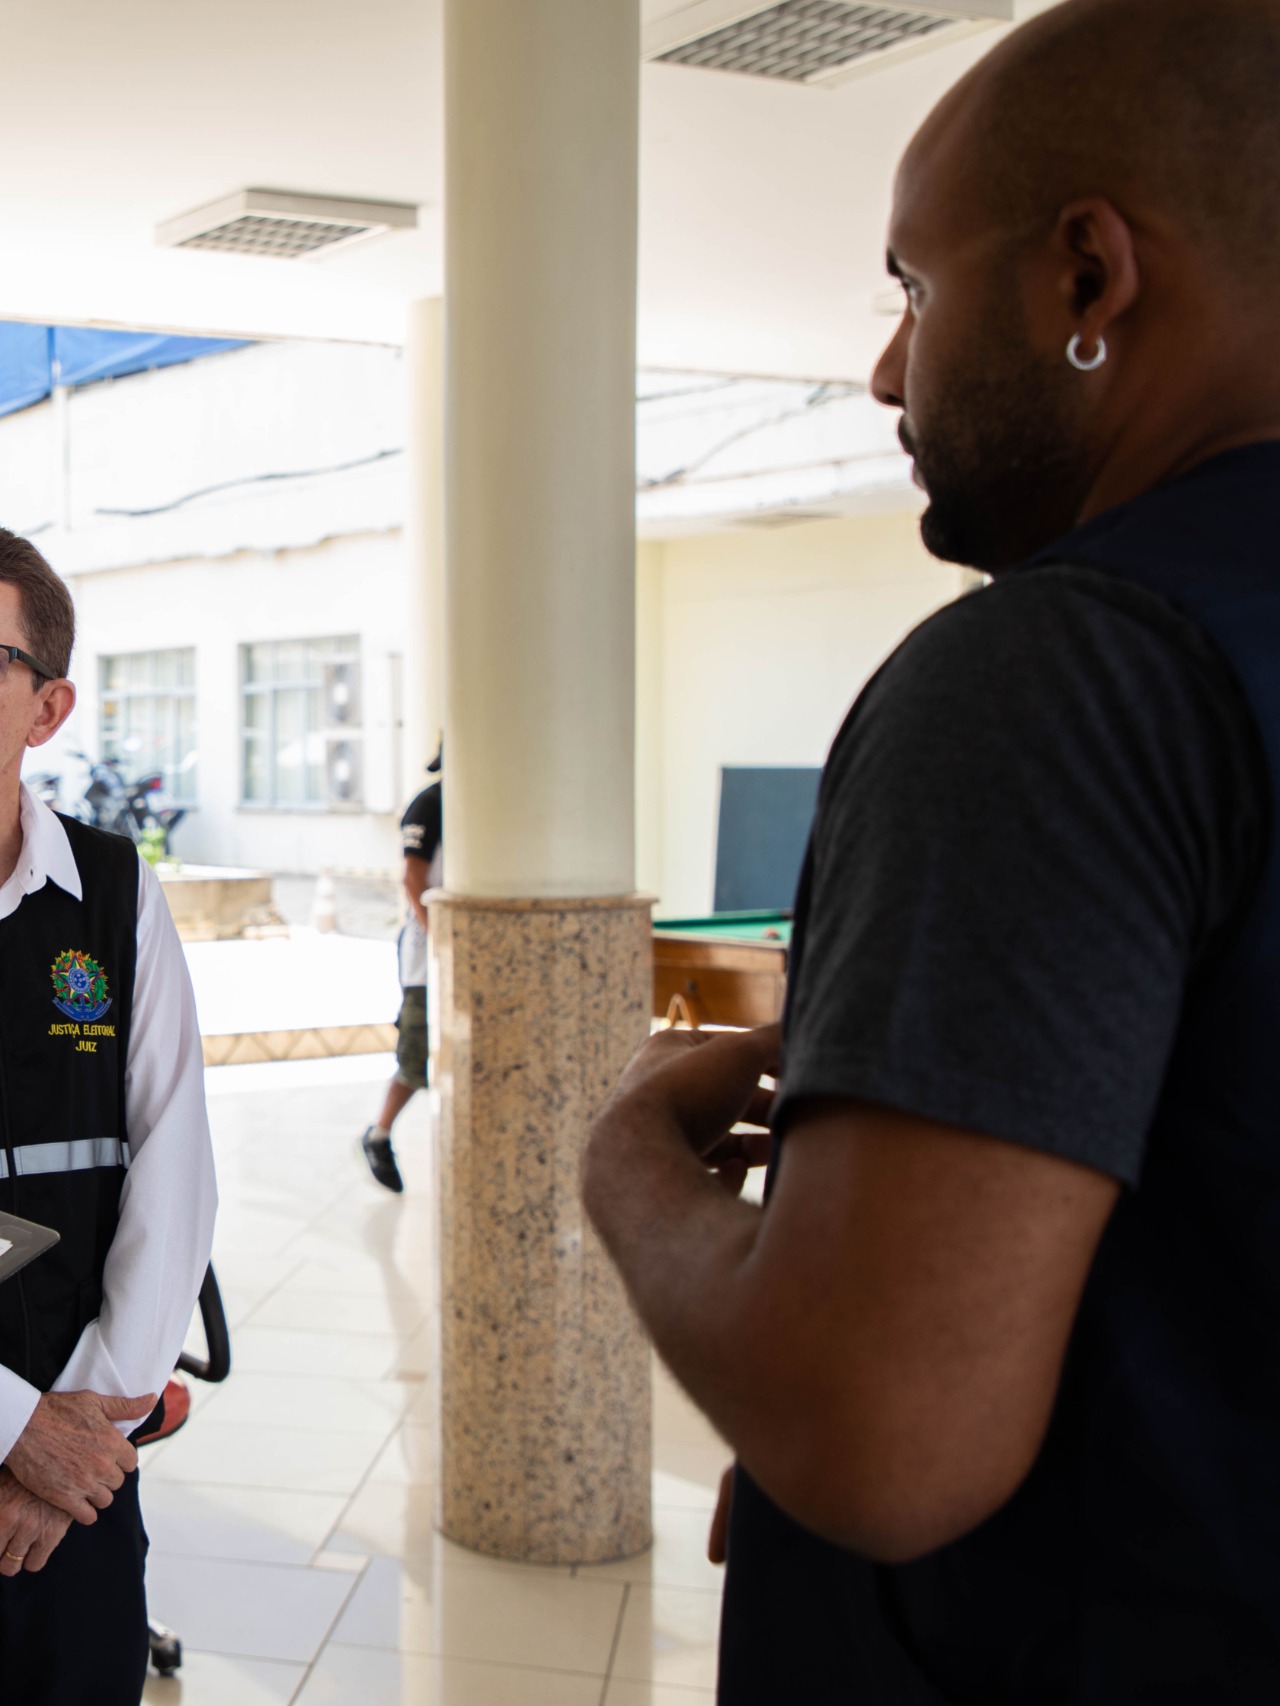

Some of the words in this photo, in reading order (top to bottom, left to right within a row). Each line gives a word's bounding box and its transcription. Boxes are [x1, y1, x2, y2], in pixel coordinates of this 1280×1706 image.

[48, 1023, 80, 1038] JUSTIÇA
[83, 1024, 116, 1037] ELEITORAL
[75, 1040, 97, 1052] JUIZ
